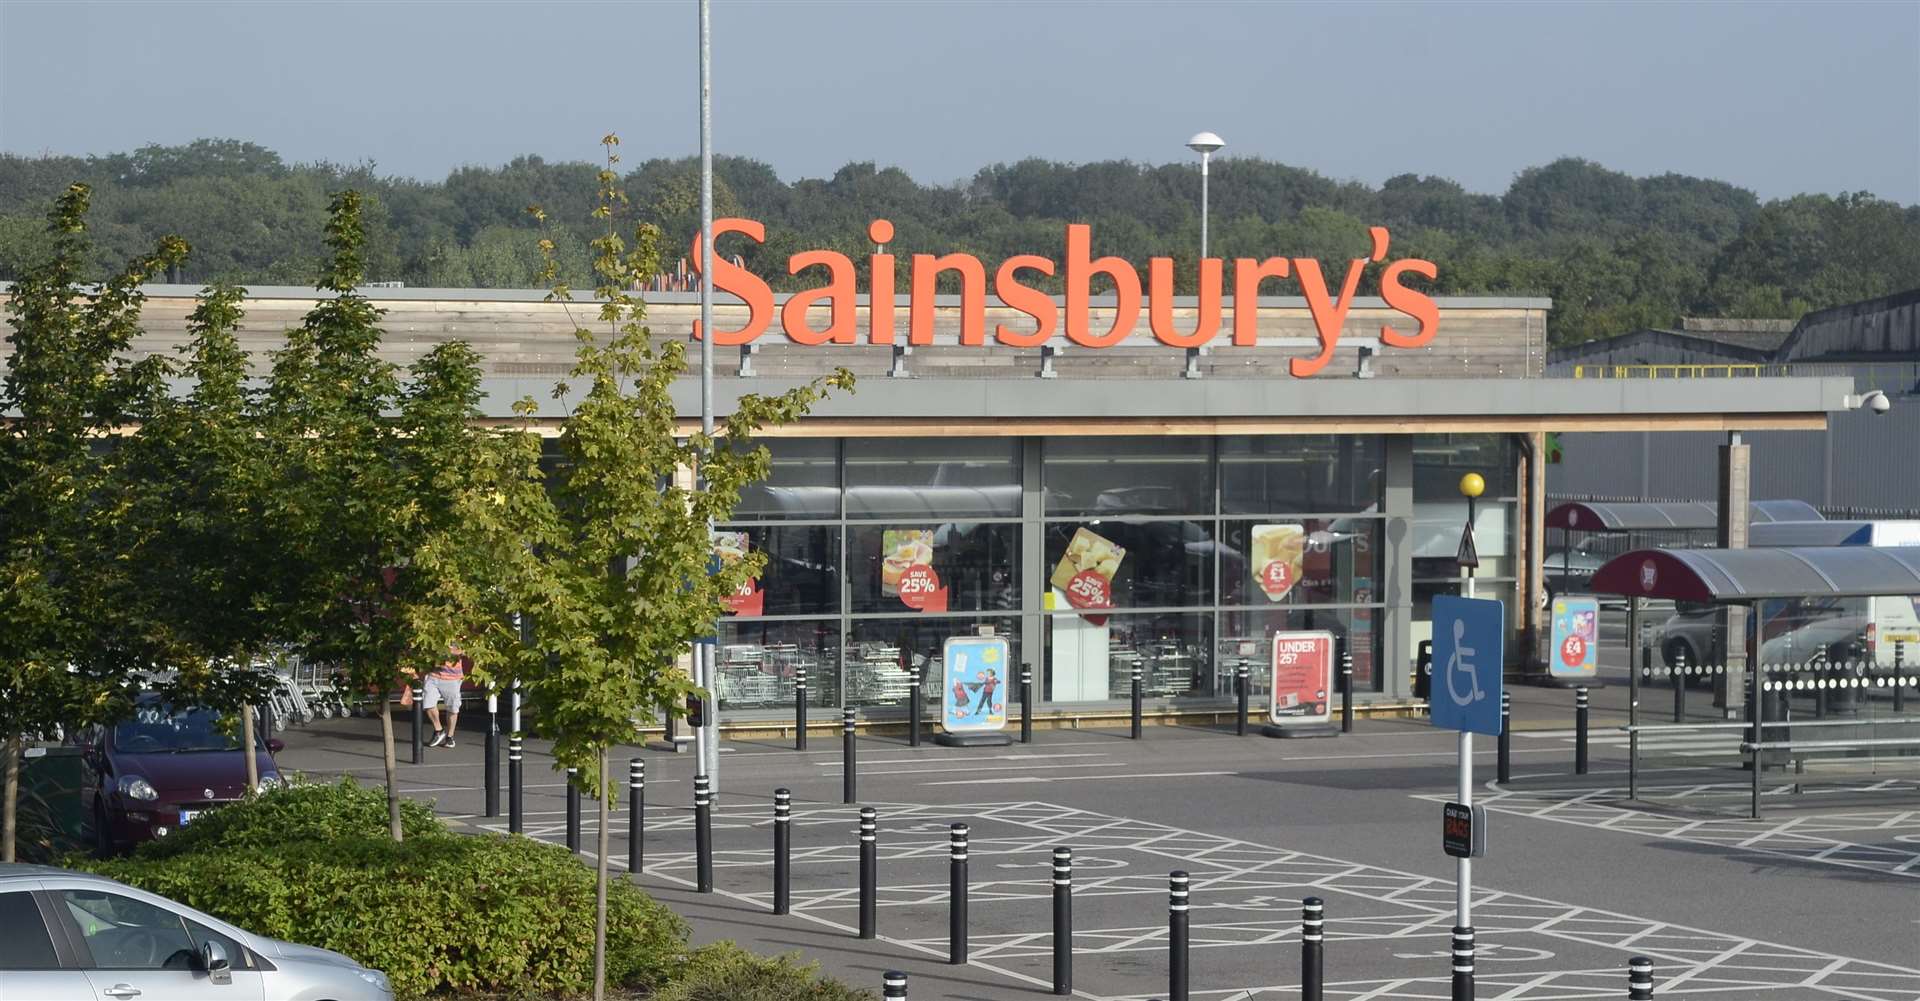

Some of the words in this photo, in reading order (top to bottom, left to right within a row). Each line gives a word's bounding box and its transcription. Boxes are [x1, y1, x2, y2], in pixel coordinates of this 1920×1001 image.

[692, 217, 1440, 377] Sainsbury's
[910, 570, 927, 578] SAVE
[1270, 568, 1286, 580] £1
[901, 578, 936, 593] 25%
[1070, 577, 1104, 604] 25%
[1280, 641, 1316, 653] UNDER
[1566, 641, 1581, 655] £4
[1280, 653, 1297, 665] 25?
